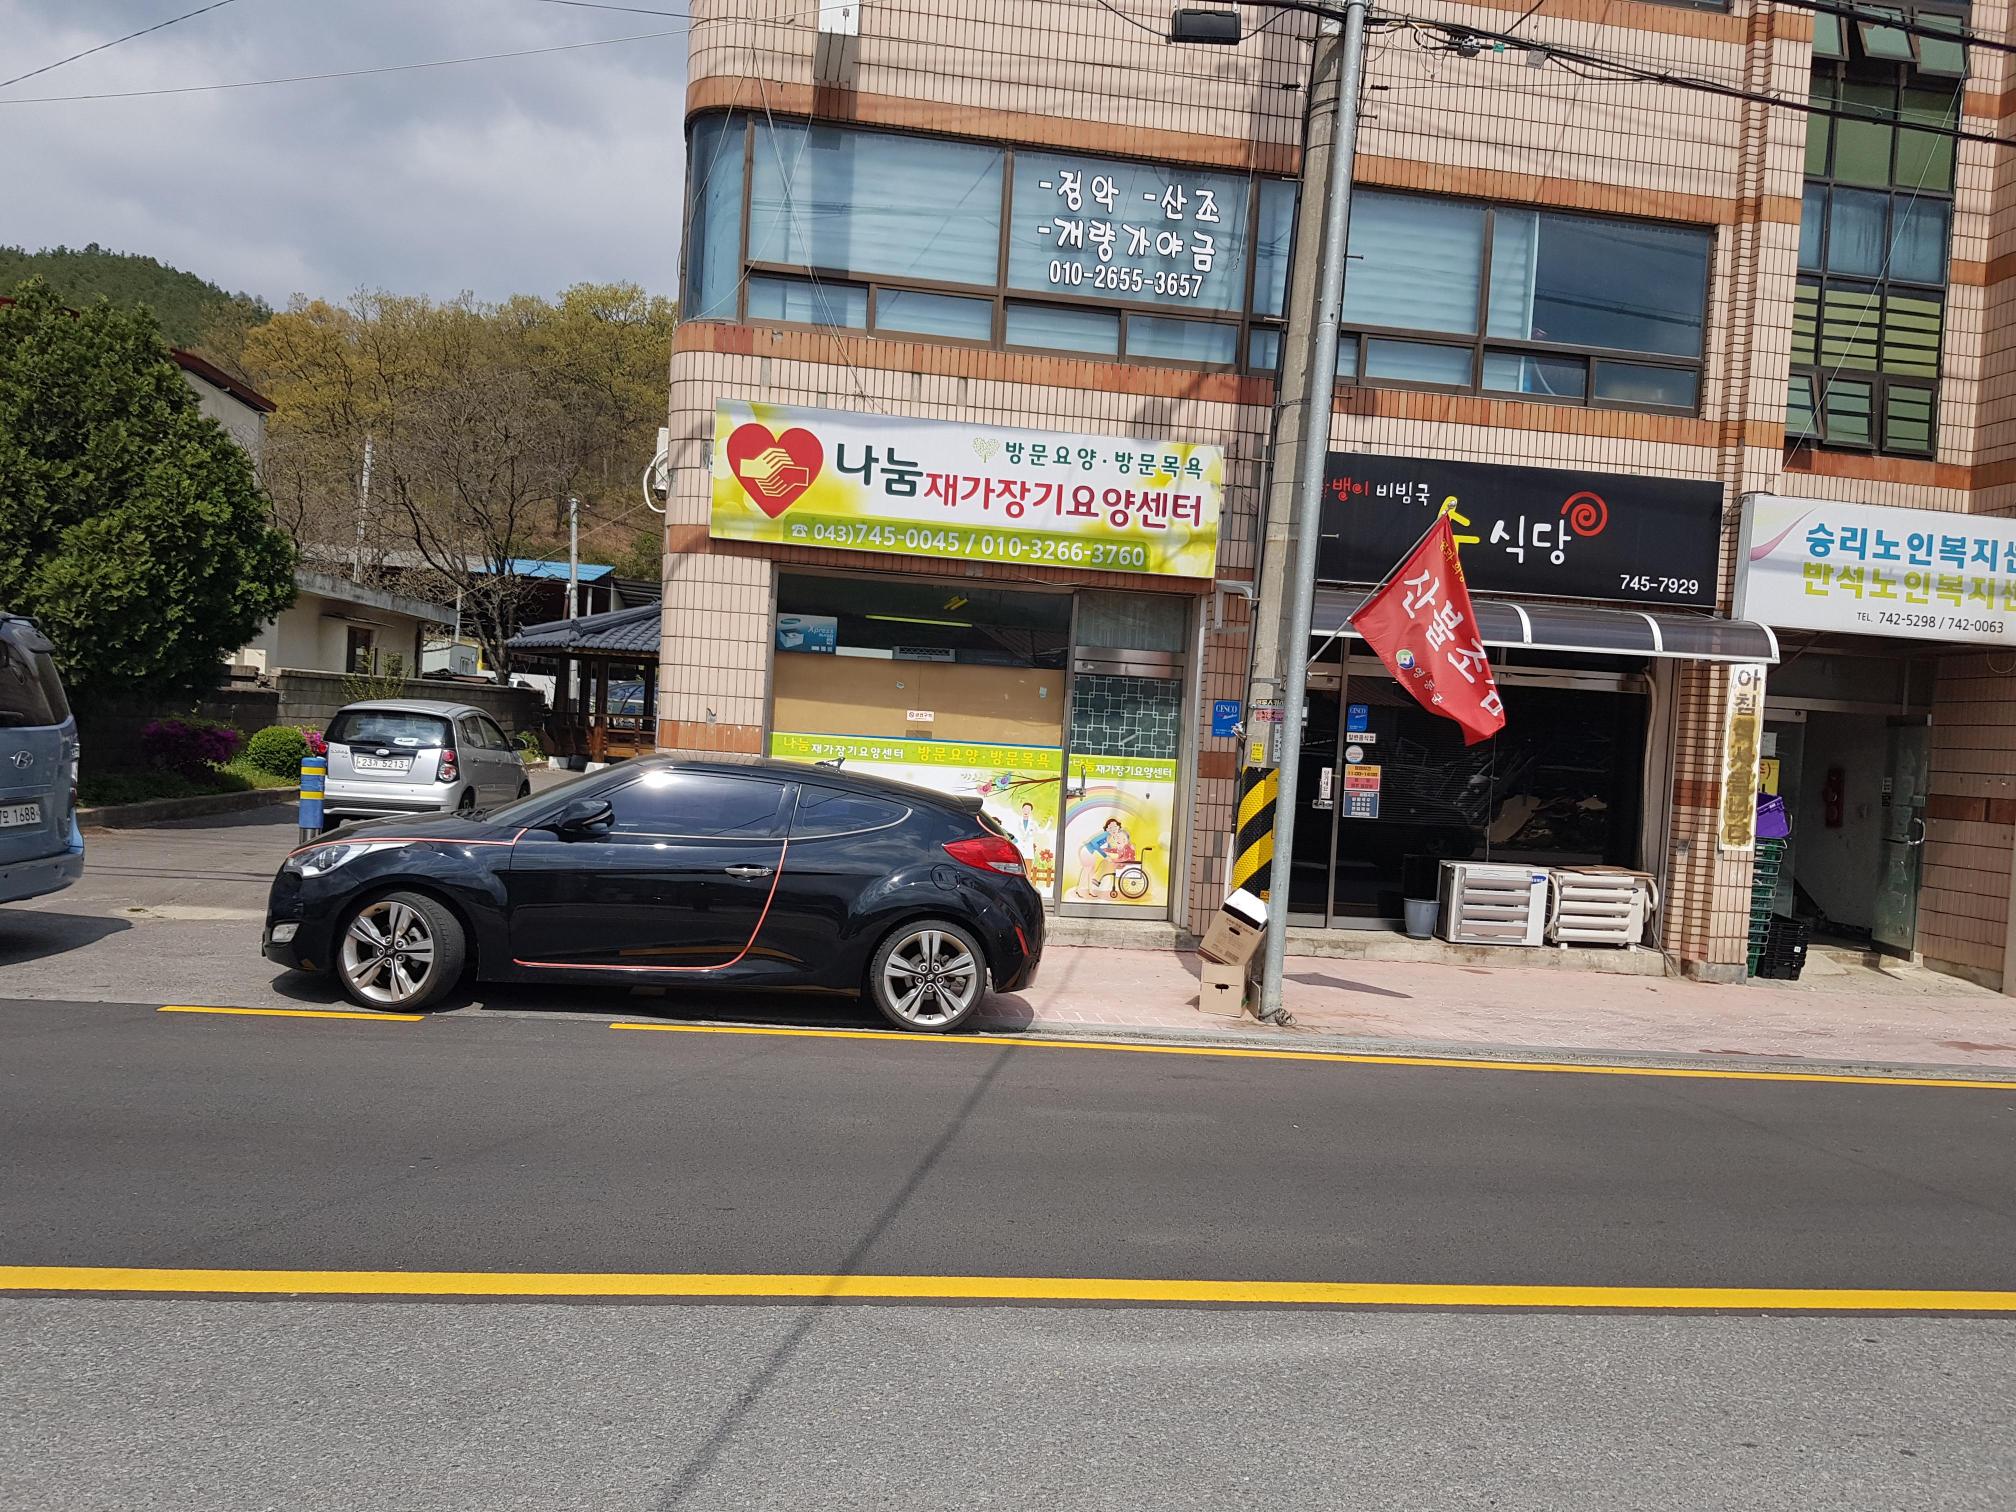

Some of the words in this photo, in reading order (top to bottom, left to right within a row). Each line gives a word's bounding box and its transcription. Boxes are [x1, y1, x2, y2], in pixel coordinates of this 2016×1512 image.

[1049, 260, 1203, 298] 010-2655-3657
[1324, 477, 1369, 502] 뱅이
[814, 524, 960, 552] 043)745-0045
[981, 535, 1145, 567] 010-3266-3760
[1619, 574, 1699, 596] 745-7929
[808, 624, 834, 635] Xpress
[1879, 611, 1936, 629] 742-5298
[1948, 616, 2005, 634] 742-0063
[14, 806, 36, 824] 1688
